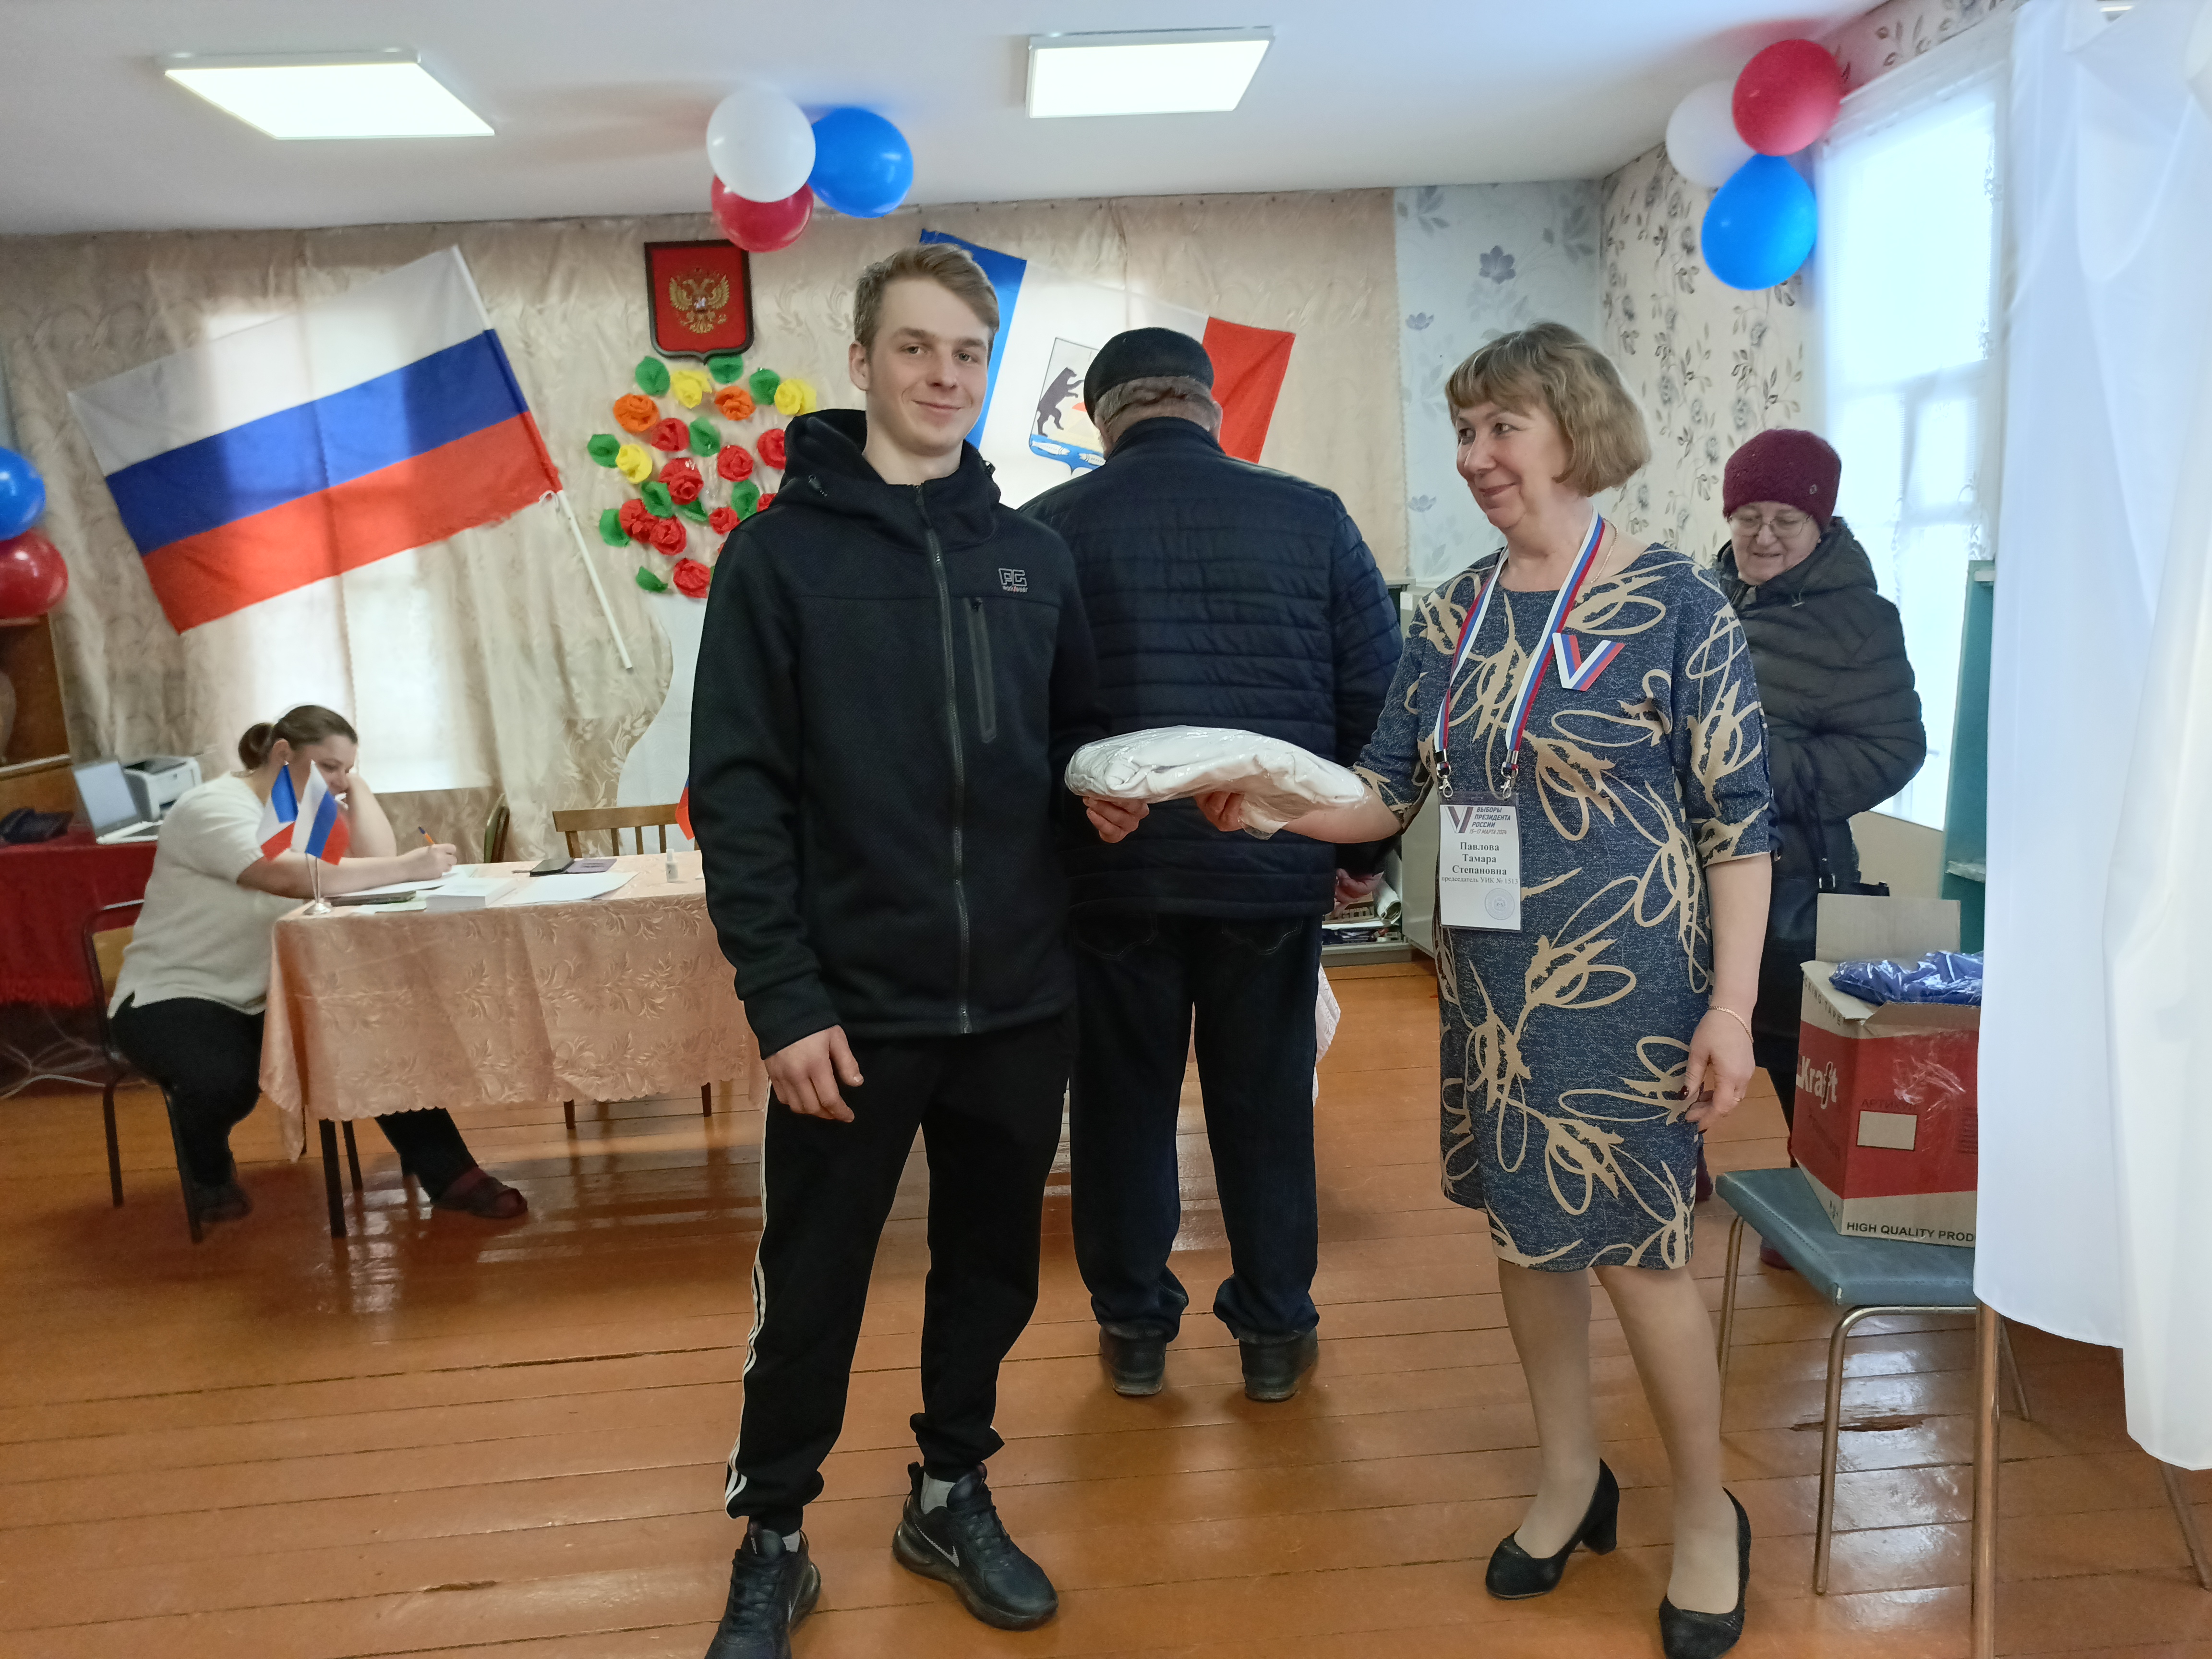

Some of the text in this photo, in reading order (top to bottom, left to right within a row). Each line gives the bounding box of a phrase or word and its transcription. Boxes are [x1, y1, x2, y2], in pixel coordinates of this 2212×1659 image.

[1460, 842, 1499, 851] Павлова
[1462, 854, 1496, 865] Тамара
[1452, 865, 1507, 875] Степановна
[1825, 1000, 1841, 1026] TAPE
[1847, 1222, 1975, 1242] HIGH QUALITY PROD
